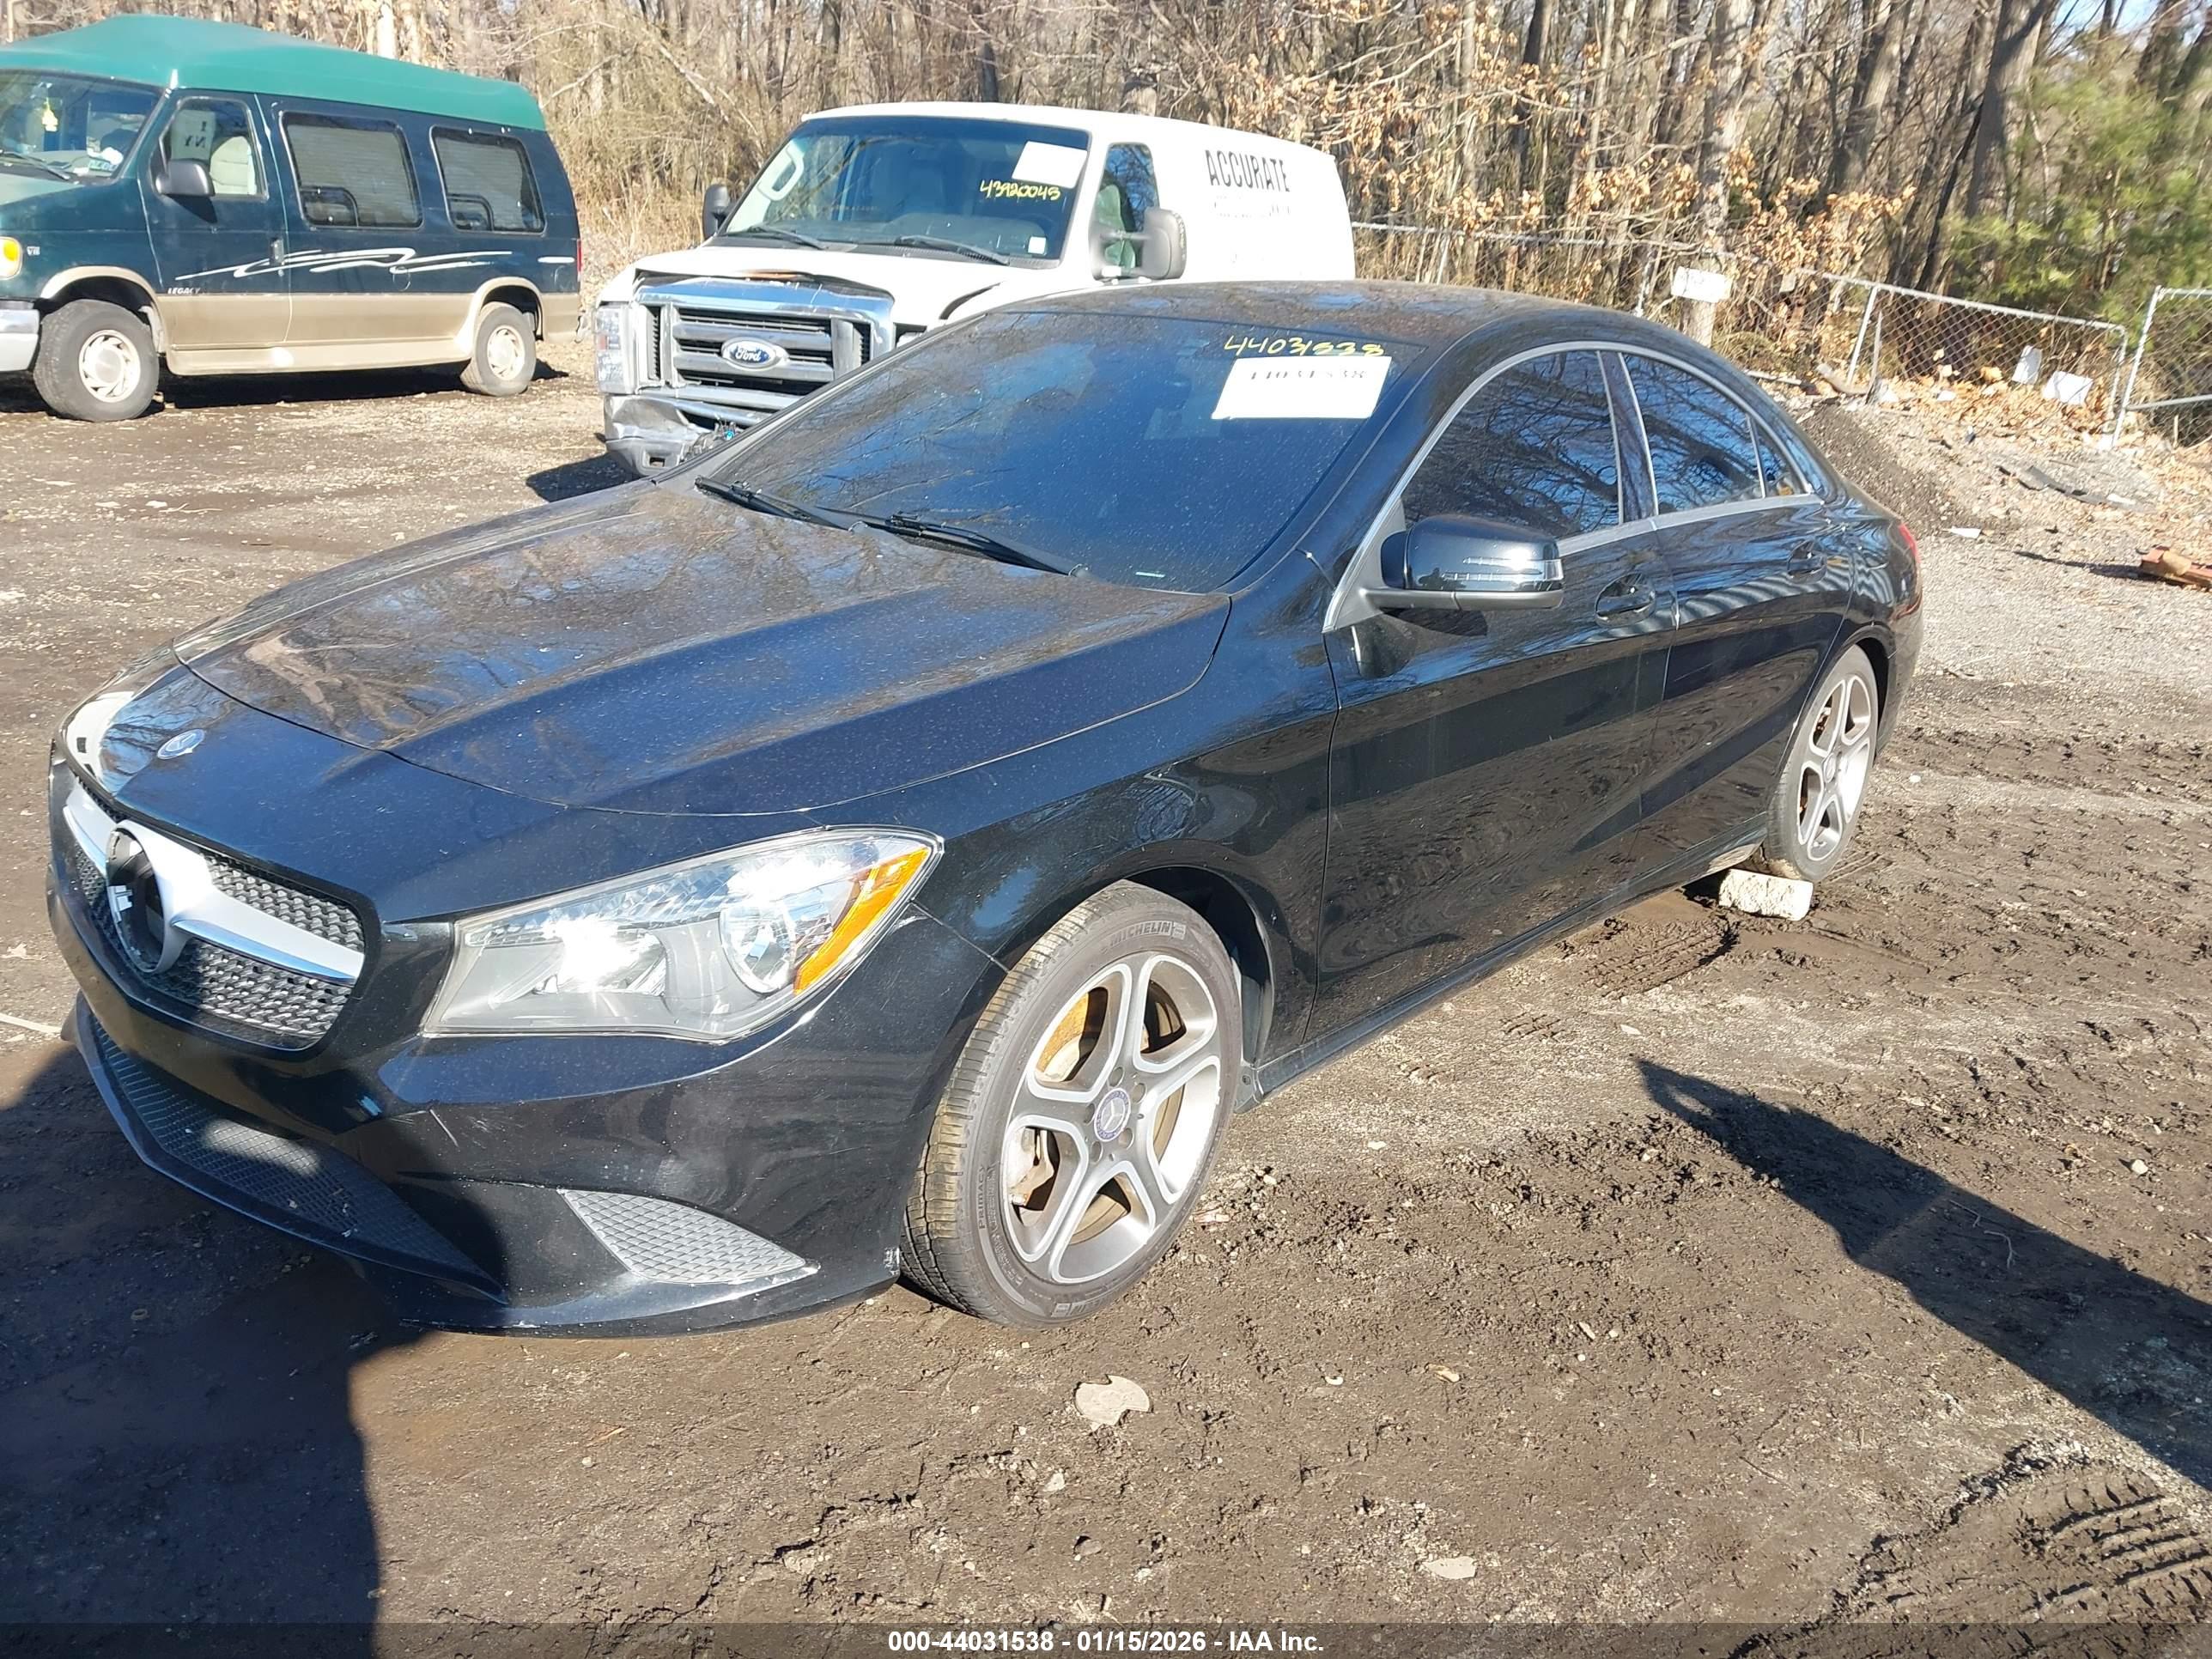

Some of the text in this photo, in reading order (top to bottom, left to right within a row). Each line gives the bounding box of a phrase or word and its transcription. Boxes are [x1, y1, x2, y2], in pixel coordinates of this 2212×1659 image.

[1205, 149, 1290, 192] ACCURATE
[980, 179, 1060, 200] 43920045
[167, 287, 201, 295] LEGACY
[733, 347, 763, 362] Ford
[1224, 335, 1384, 356] 44031538
[1110, 920, 1172, 946] MICHELIN
[977, 1164, 986, 1230] PRIMACY
